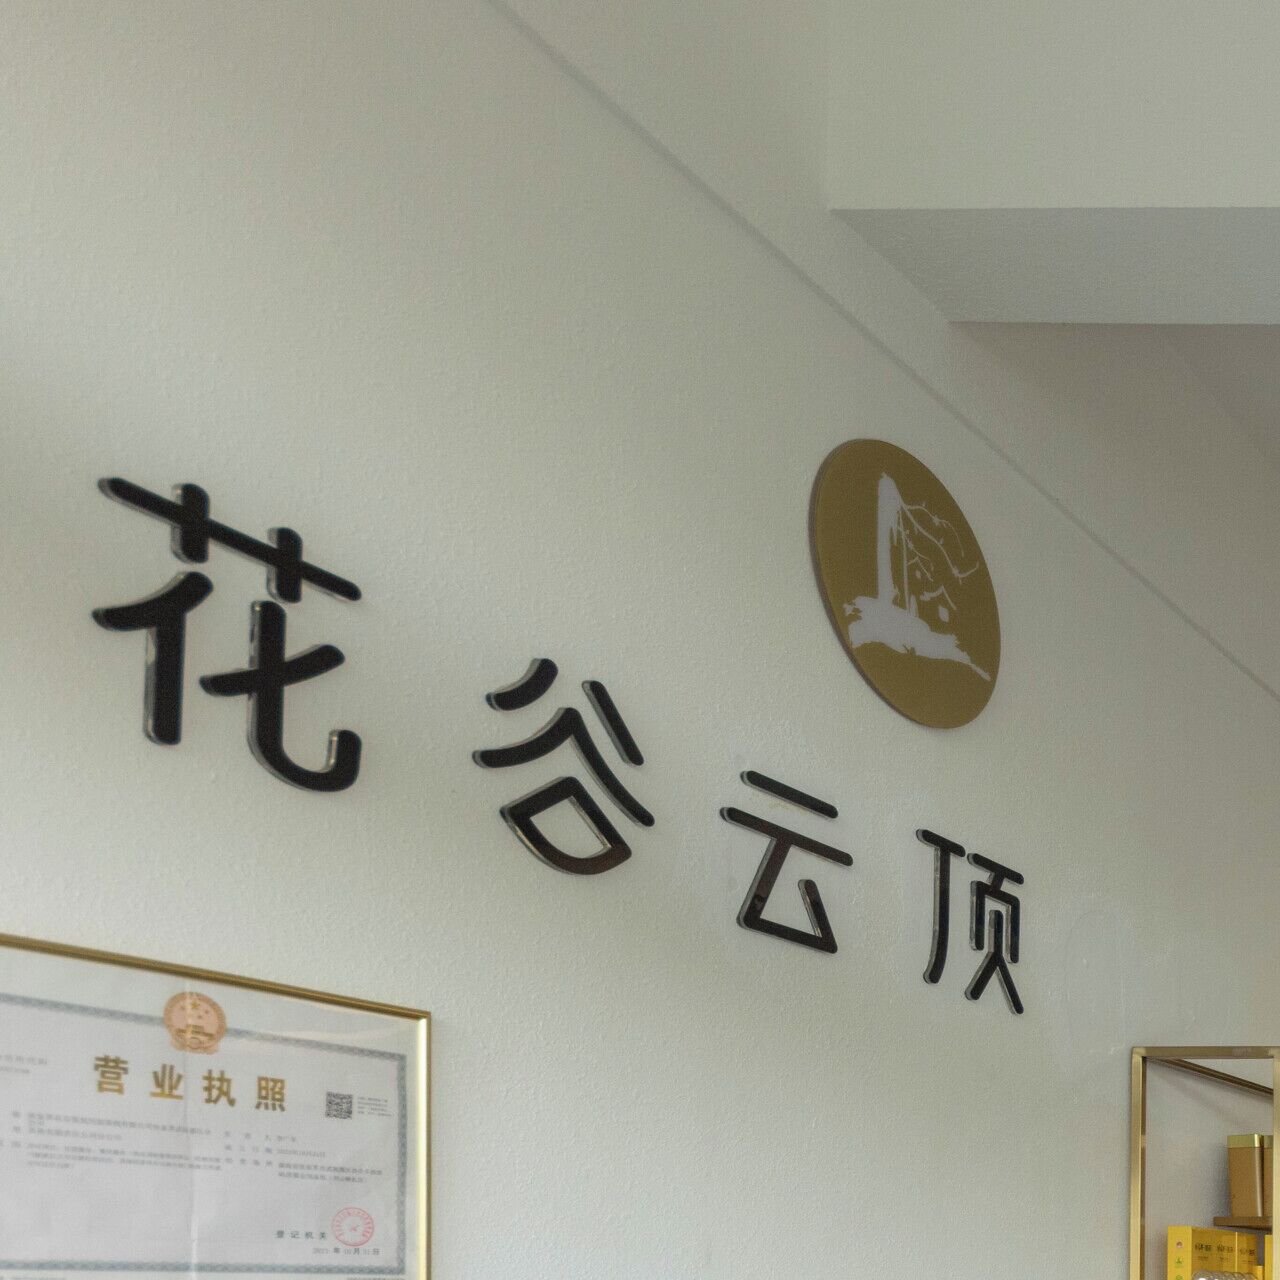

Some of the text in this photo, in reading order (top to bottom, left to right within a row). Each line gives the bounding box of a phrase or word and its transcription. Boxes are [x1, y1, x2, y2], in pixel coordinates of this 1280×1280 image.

[92, 476, 1026, 1016] 花谷云顶
[92, 1053, 288, 1113] 营业执照
